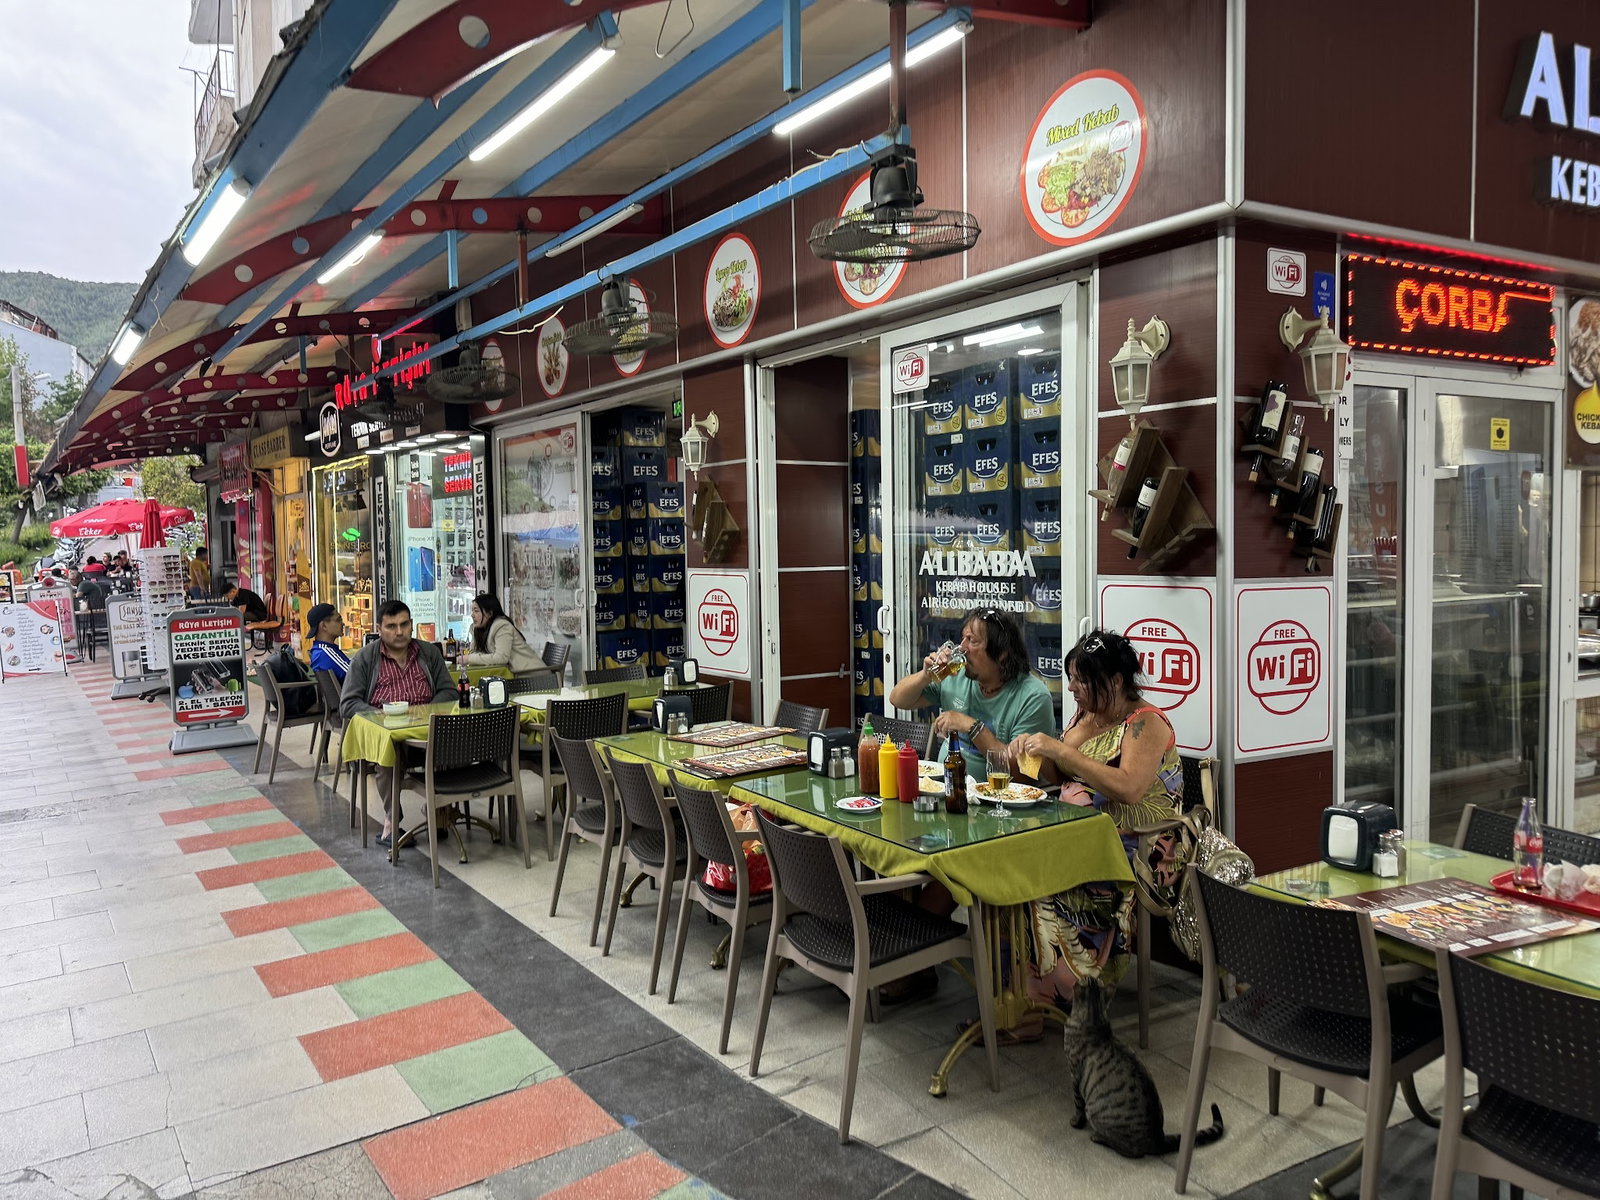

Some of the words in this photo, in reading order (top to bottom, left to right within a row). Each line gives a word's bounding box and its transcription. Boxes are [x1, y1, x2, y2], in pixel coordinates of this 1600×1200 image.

[1520, 30, 1600, 135] AL
[1046, 117, 1080, 147] Mixed
[1082, 103, 1120, 135] Kebab
[1274, 264, 1298, 280] WiFi
[899, 360, 922, 378] WiFi
[1031, 379, 1059, 397] EFES
[974, 391, 997, 408] EFES
[933, 400, 954, 415] EFES
[975, 456, 999, 472] EFES
[1032, 451, 1060, 466] EFES
[633, 465, 659, 476] EFES
[933, 463, 954, 476] EFES
[659, 498, 679, 507] EFES
[376, 481, 387, 553] TEKNİK
[475, 461, 487, 562] TECHNICAL
[935, 525, 956, 537] EFES
[976, 523, 1000, 536] EFES
[1034, 521, 1061, 534] EFES
[661, 534, 681, 544] EFES
[663, 571, 682, 581] EFES
[711, 594, 724, 602] FREE
[1035, 589, 1062, 601] EFES
[664, 608, 684, 618] EFES
[201, 619, 233, 628] İLETİŞİM
[702, 612, 735, 633] WiFi
[174, 628, 239, 642] GARANTİLİ
[1141, 626, 1167, 637] FREE
[1274, 628, 1296, 639] FREE
[174, 640, 206, 648] TEKNİK
[208, 637, 240, 646] SERVİS
[175, 645, 206, 653] YEDEK
[175, 649, 240, 660] AKSESUAR
[617, 648, 638, 659] EFES
[667, 645, 685, 655] EFES
[1037, 656, 1063, 671] EFES
[1256, 651, 1313, 682] WiFi
[204, 694, 242, 703] TELEFON
